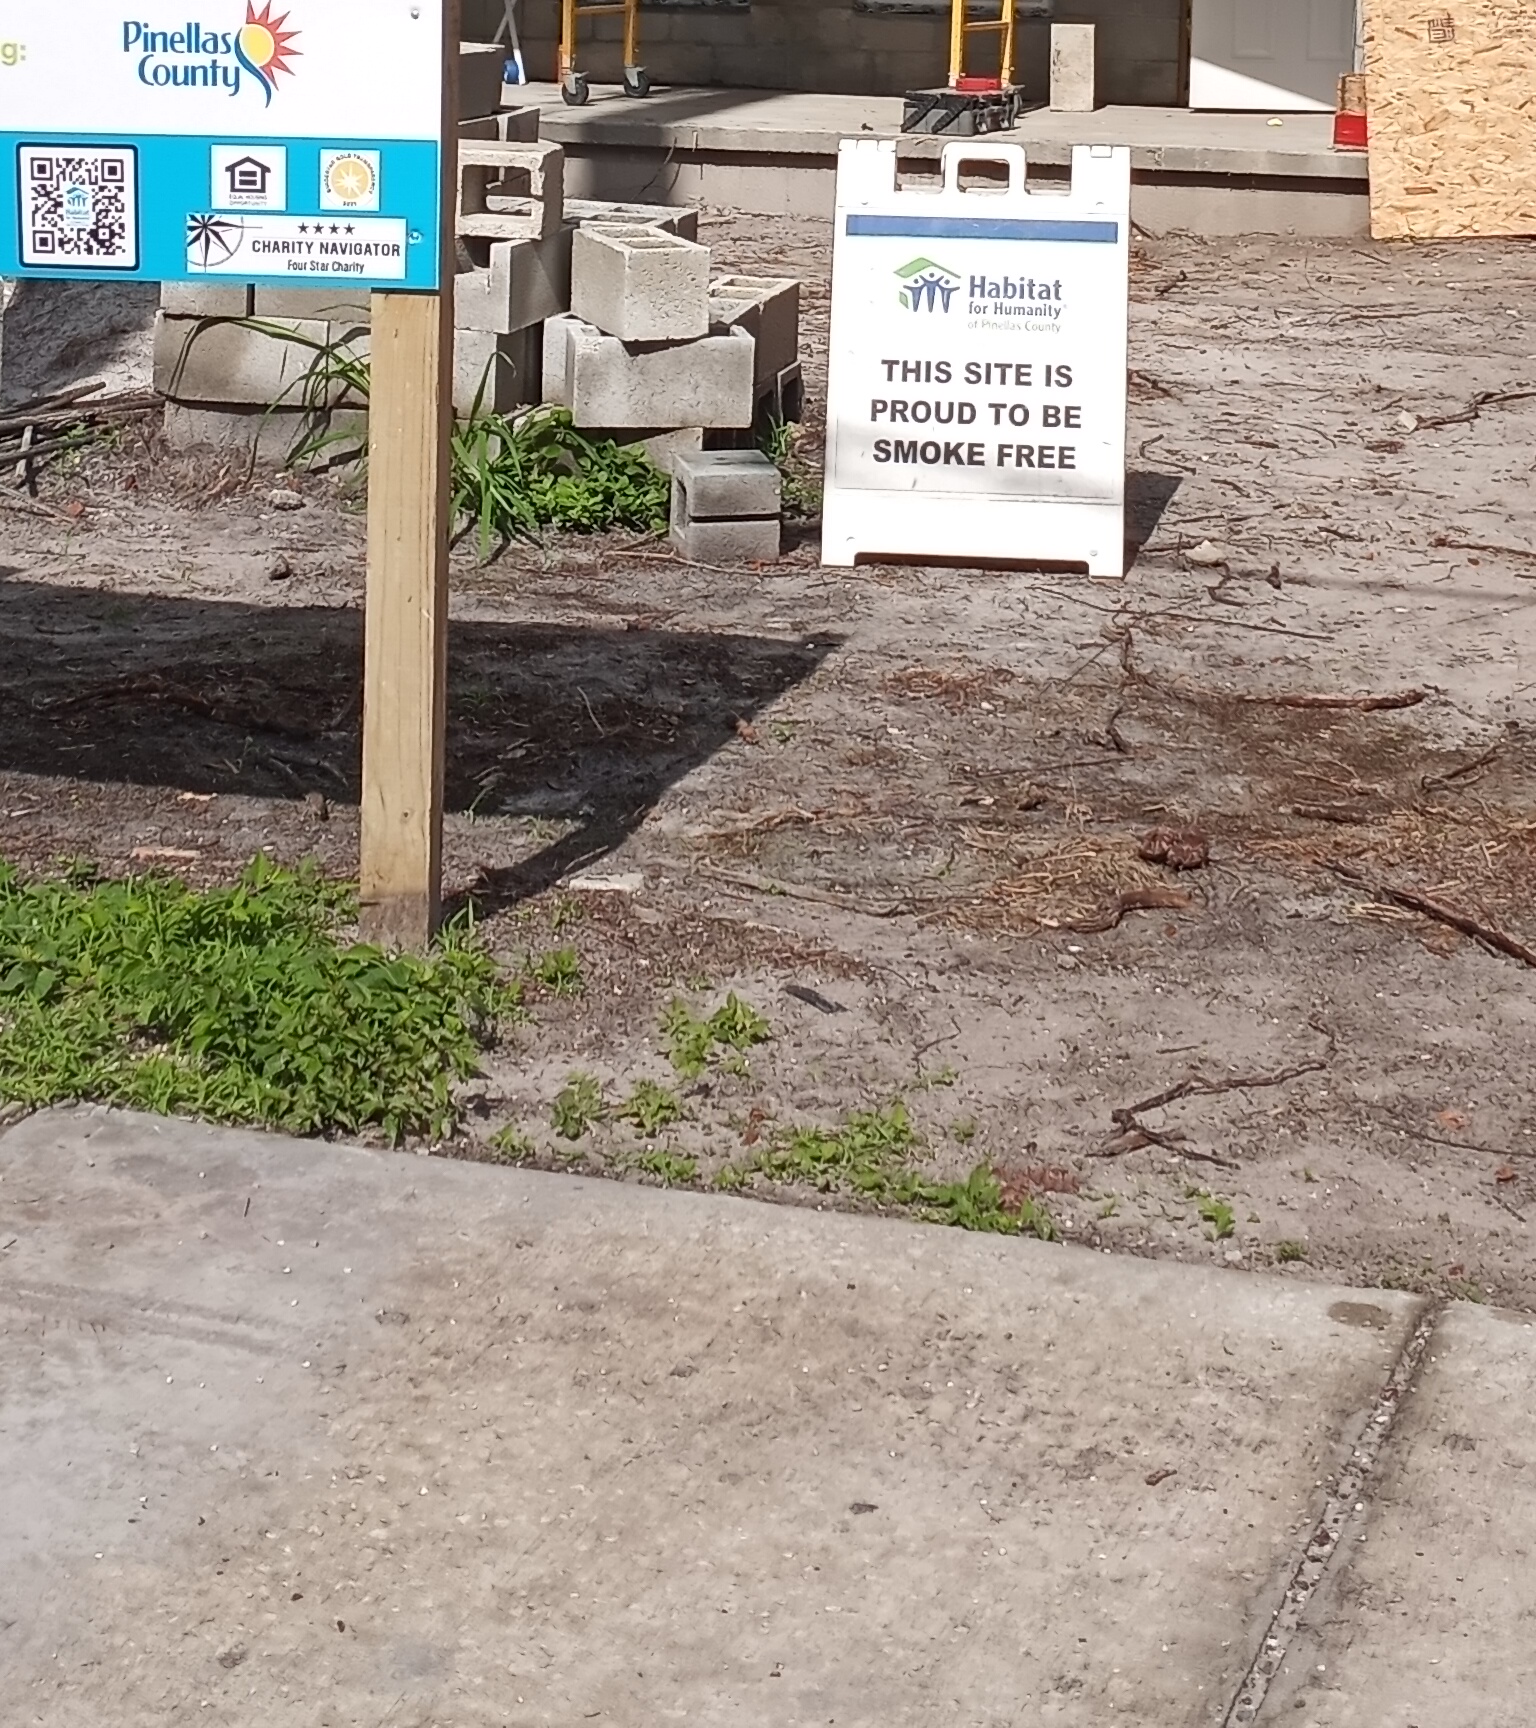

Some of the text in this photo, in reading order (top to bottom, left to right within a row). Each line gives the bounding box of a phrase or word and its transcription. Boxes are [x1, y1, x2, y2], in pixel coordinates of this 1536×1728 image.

[124, 21, 231, 54] Pinellas
[138, 54, 241, 96] County
[252, 240, 400, 256] CHARITY NAVIGATOR
[288, 260, 364, 274] Four Star Charity
[969, 275, 1062, 300] Habitat
[969, 301, 1061, 320] for Humanity
[1025, 321, 1061, 334] County
[881, 360, 1072, 387] THIS SITE IS
[871, 399, 1081, 428] PROUD TO BE
[873, 439, 1076, 469] SMOKE FREE
